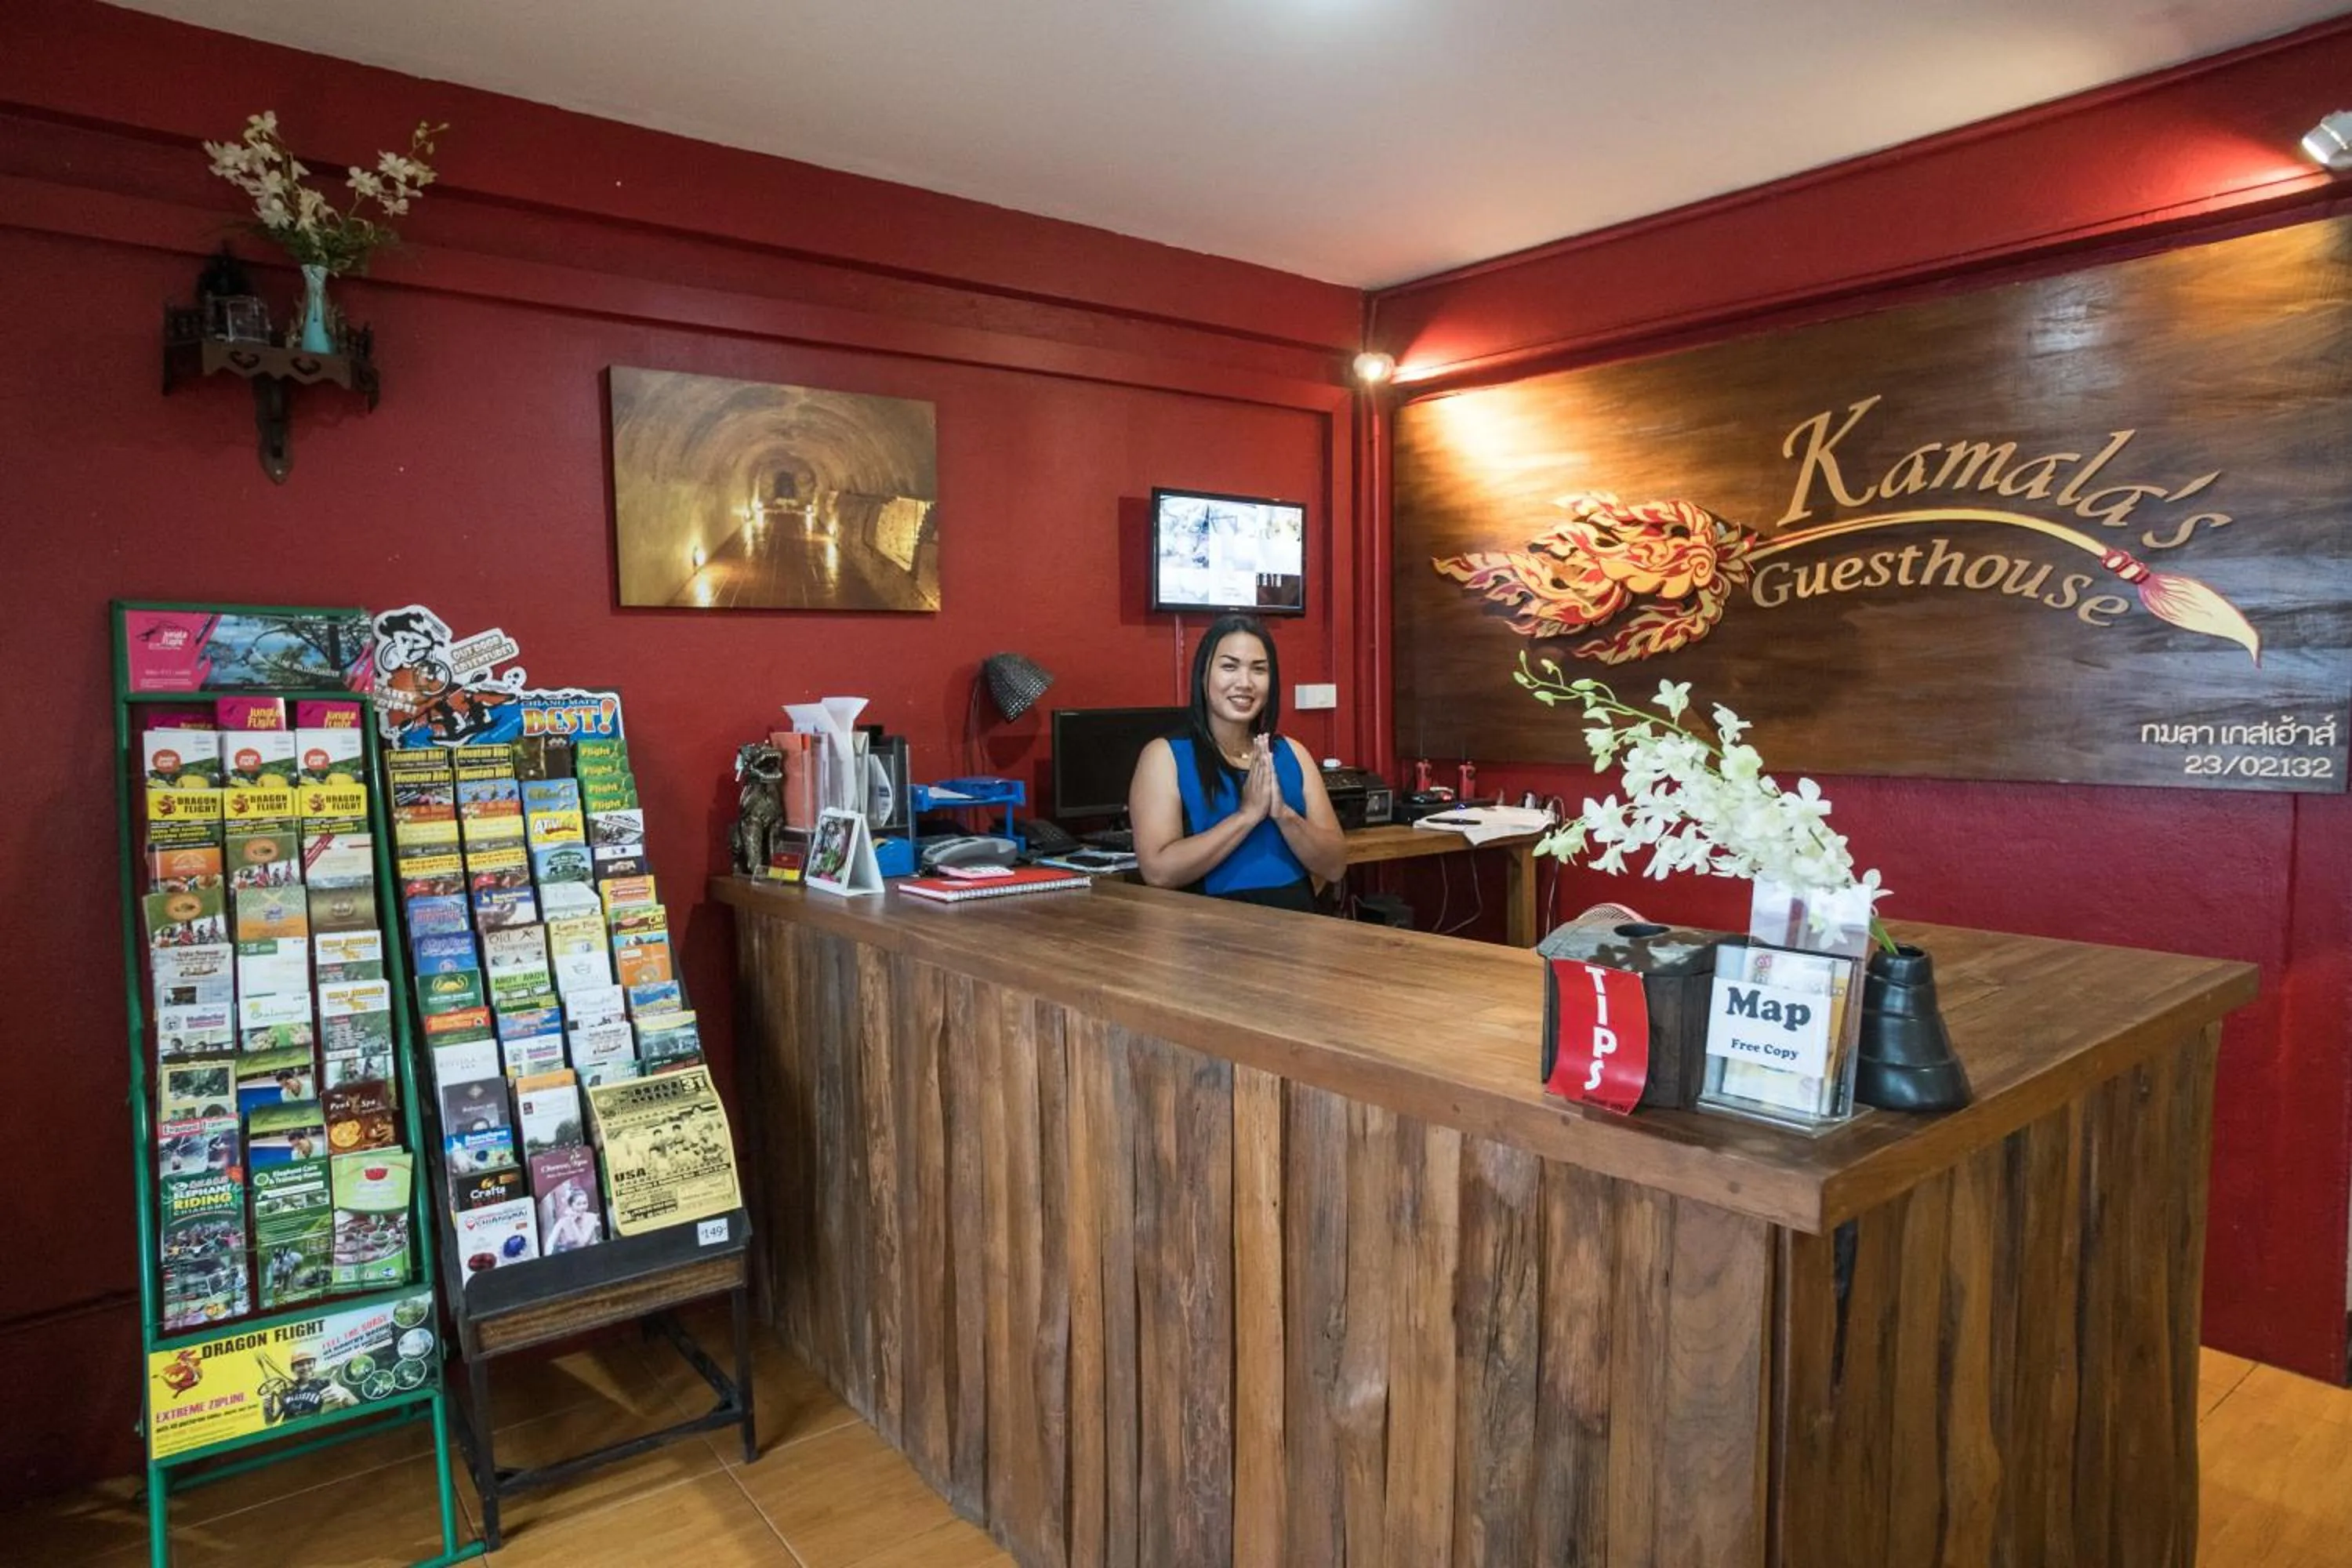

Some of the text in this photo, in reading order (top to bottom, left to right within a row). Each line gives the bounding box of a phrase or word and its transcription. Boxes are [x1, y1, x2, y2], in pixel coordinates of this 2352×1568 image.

[1775, 394, 2232, 549] Kamala's
[1751, 538, 2131, 626] Guesthouse
[2140, 723, 2214, 746] กมลา
[2183, 754, 2334, 779] 23/02132
[177, 796, 216, 806] DRAGON
[183, 804, 216, 813] FLIGHT
[249, 793, 287, 804] DRAGON
[256, 802, 288, 812] FLIGHT
[326, 794, 361, 804] DRAGON
[332, 802, 361, 811] FLIGHT
[1726, 985, 1812, 1032] Map
[1584, 965, 1617, 1091] TIPS
[1730, 1038, 1800, 1061] Free Copy
[173, 1192, 233, 1210] RIDING
[201, 1319, 325, 1359] DRAGON FLIGHT
[156, 1402, 205, 1424] EXTREME
